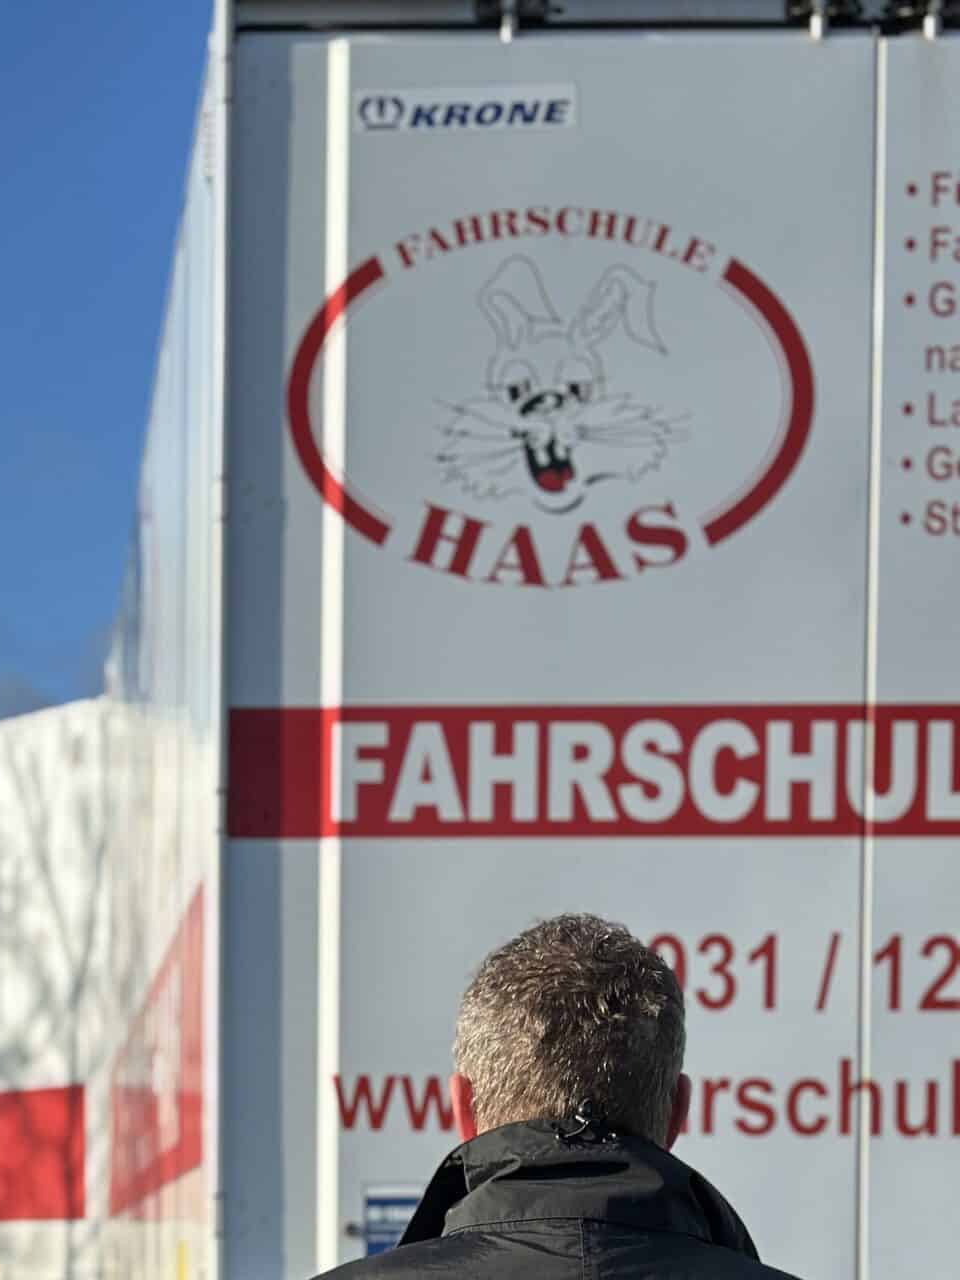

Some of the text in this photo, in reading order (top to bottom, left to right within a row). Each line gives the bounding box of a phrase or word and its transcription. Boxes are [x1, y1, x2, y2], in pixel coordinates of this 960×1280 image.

[410, 99, 571, 127] KRONE
[394, 205, 717, 272] FAHRSCHULE
[926, 445, 960, 481] G
[406, 501, 690, 588] HAAS
[330, 719, 960, 822] FAHRSCHUL
